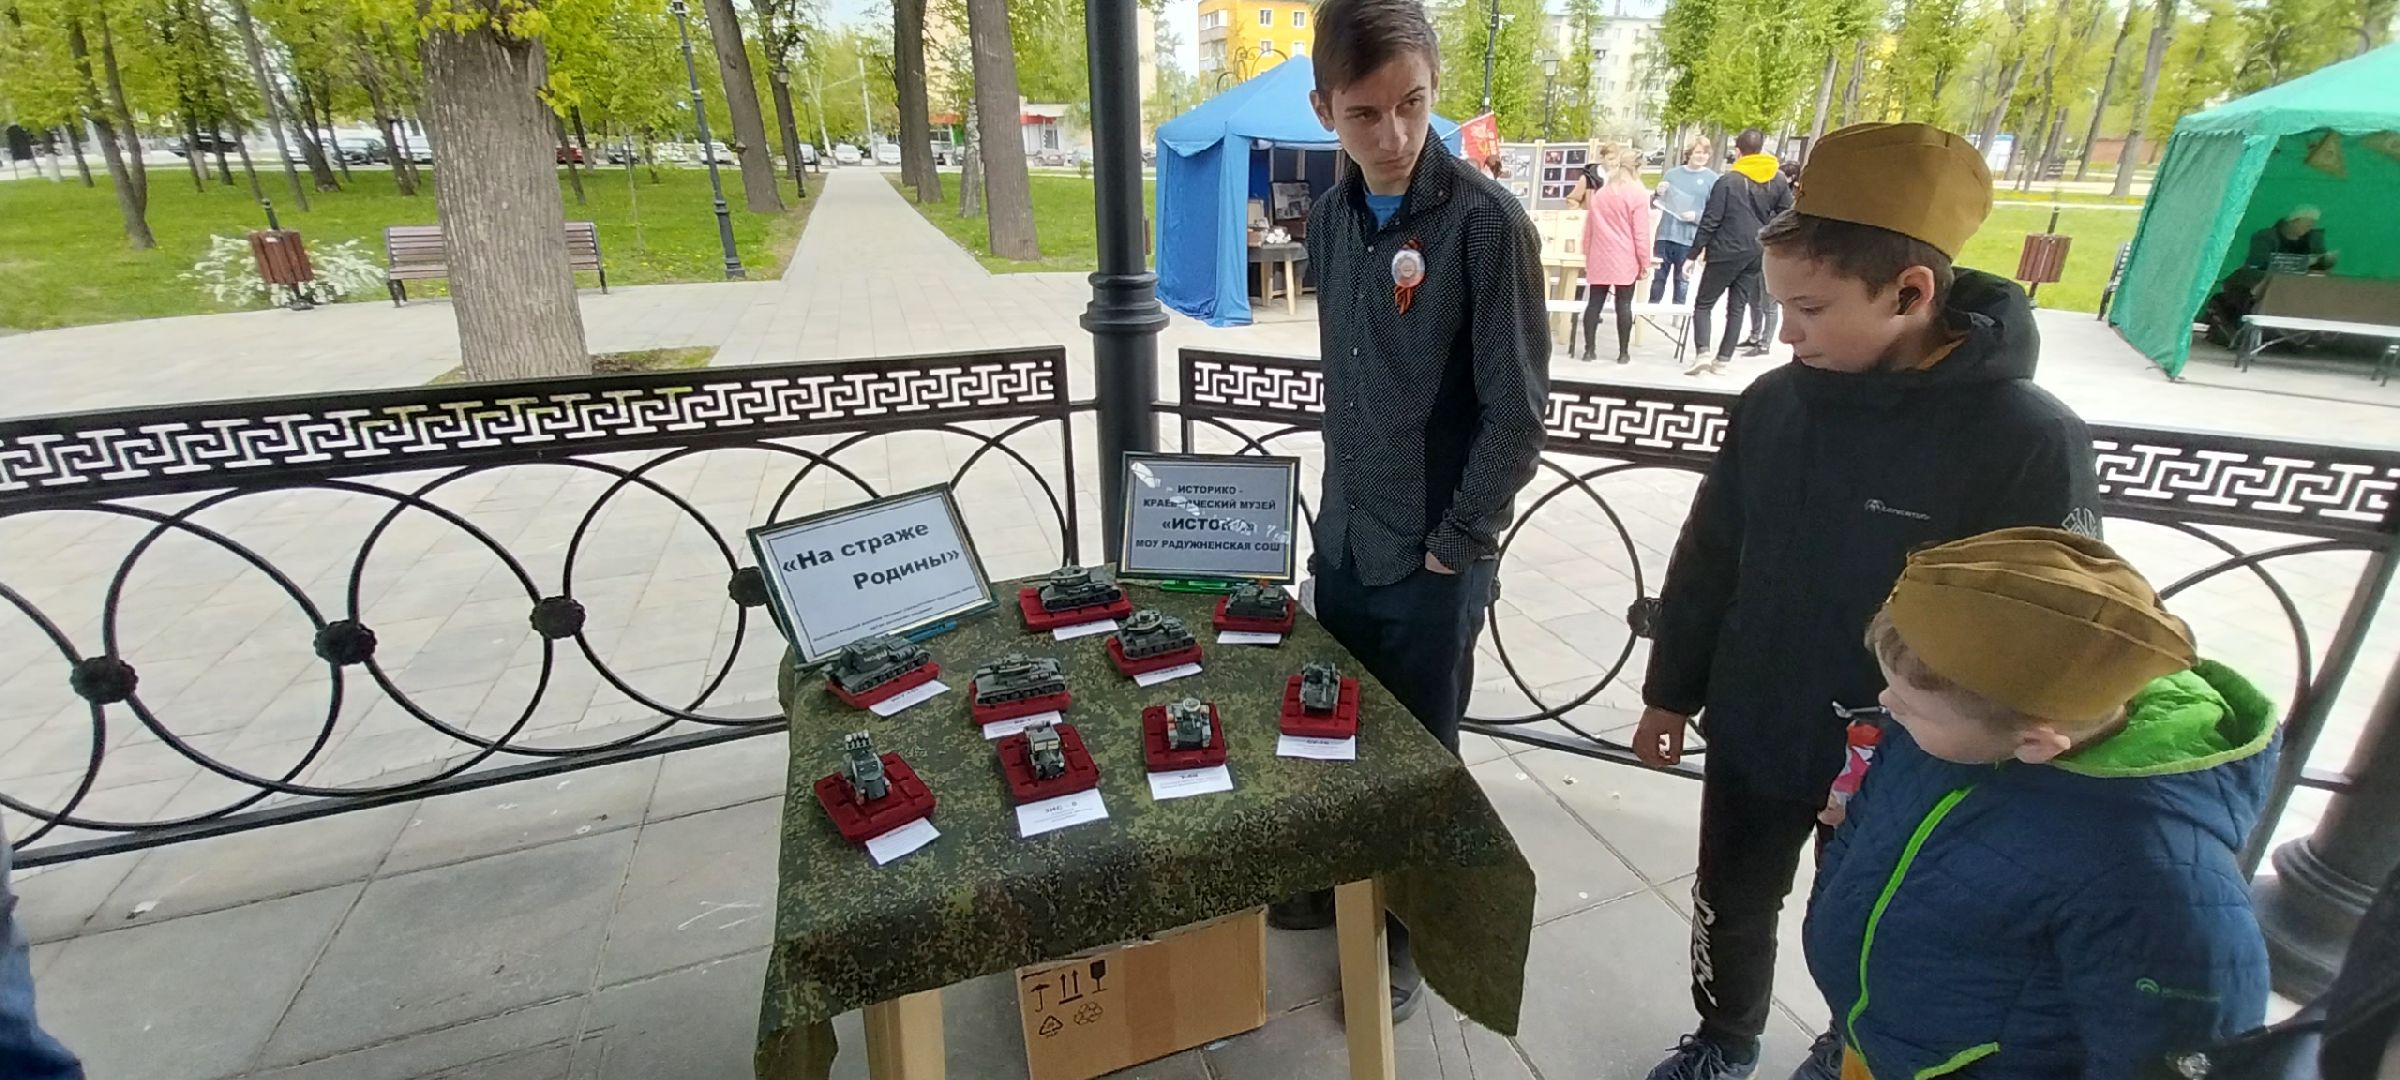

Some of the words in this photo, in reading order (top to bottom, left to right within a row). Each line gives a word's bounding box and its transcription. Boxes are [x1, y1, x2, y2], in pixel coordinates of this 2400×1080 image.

[1177, 484, 1237, 495] ИСТОРИКО
[1239, 500, 1276, 511] МУЗЕЙ
[782, 549, 835, 573] «На
[840, 523, 929, 555] страже
[1135, 539, 1158, 549] МОУ
[1161, 540, 1251, 551] РАДУЖНЕНСКАЯ
[1254, 541, 1281, 552] СОШ
[852, 549, 960, 590] Родины»
